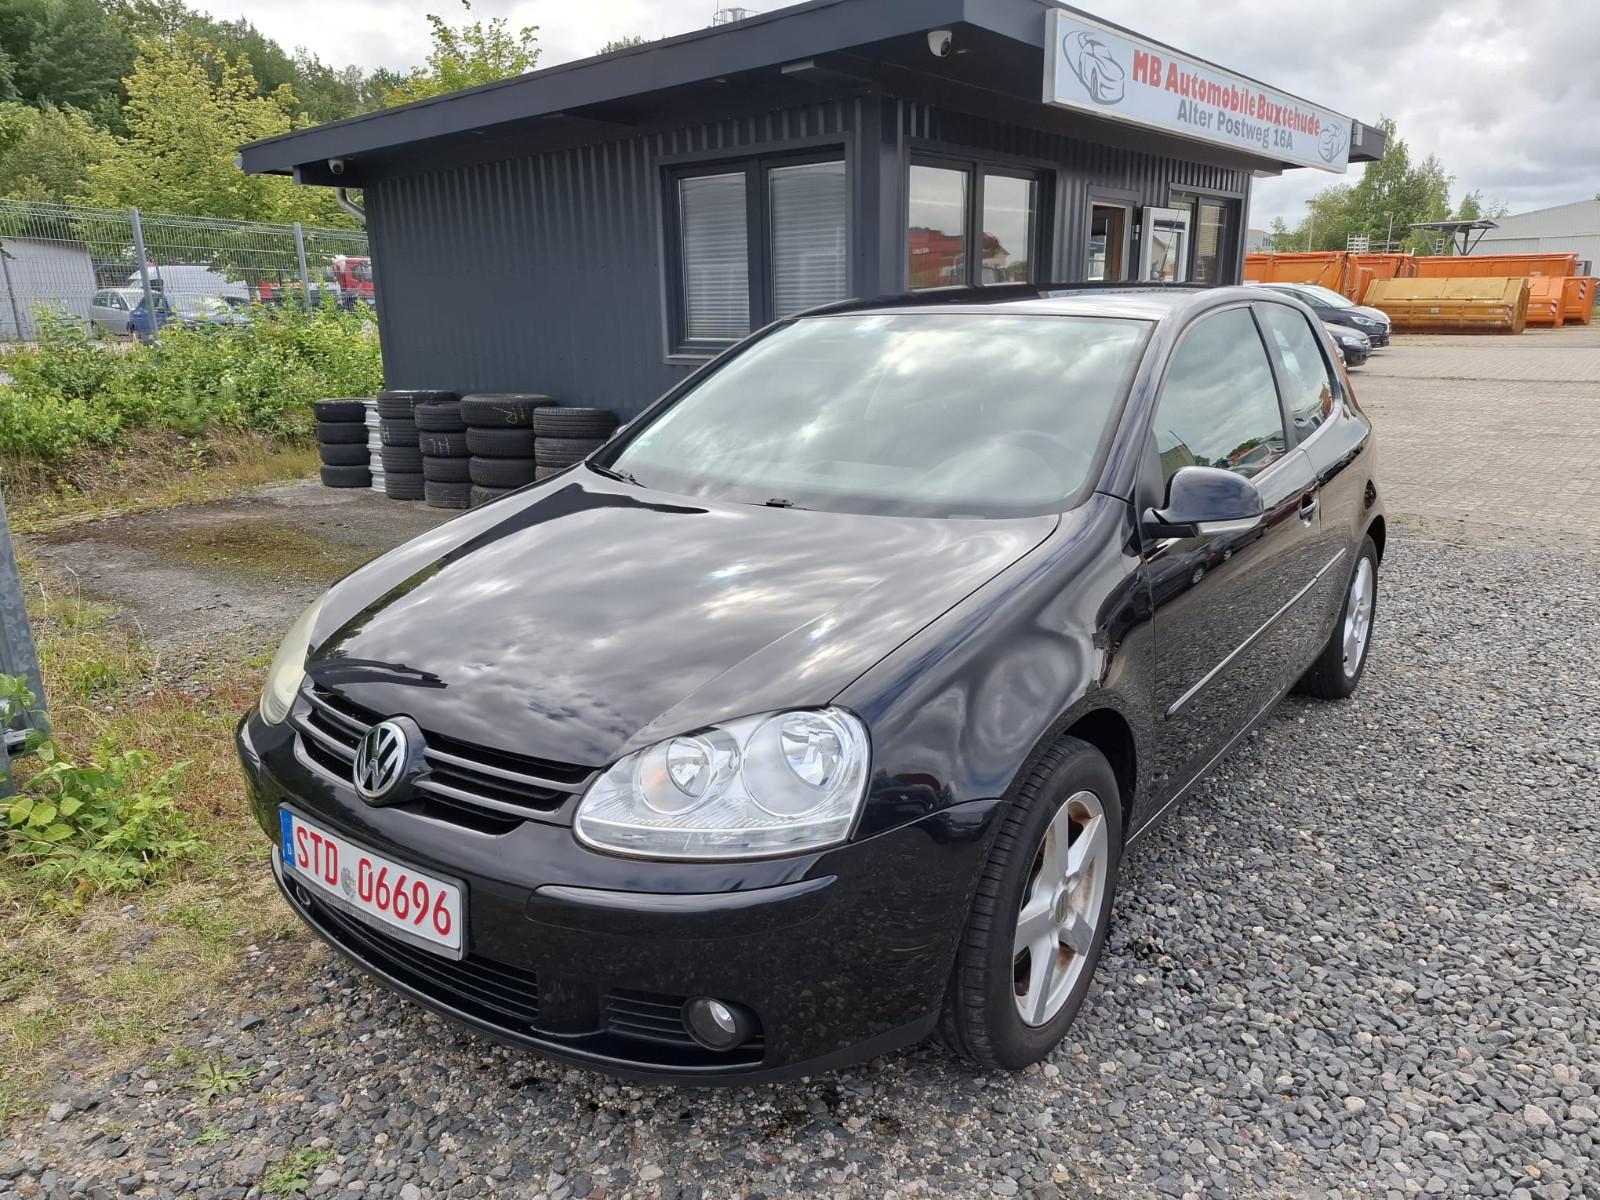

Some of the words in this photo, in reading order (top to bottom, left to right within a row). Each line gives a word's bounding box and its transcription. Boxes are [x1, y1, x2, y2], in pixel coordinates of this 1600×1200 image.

[1133, 48, 1162, 88] MB
[1165, 62, 1256, 117] Automobile
[1256, 93, 1321, 137] Buxtehude
[1177, 99, 1214, 129] Alter
[1217, 111, 1270, 149] Postweg
[1273, 127, 1294, 151] 16A
[355, 722, 407, 798] VW
[296, 825, 338, 886] STD
[357, 857, 452, 937] 06696
